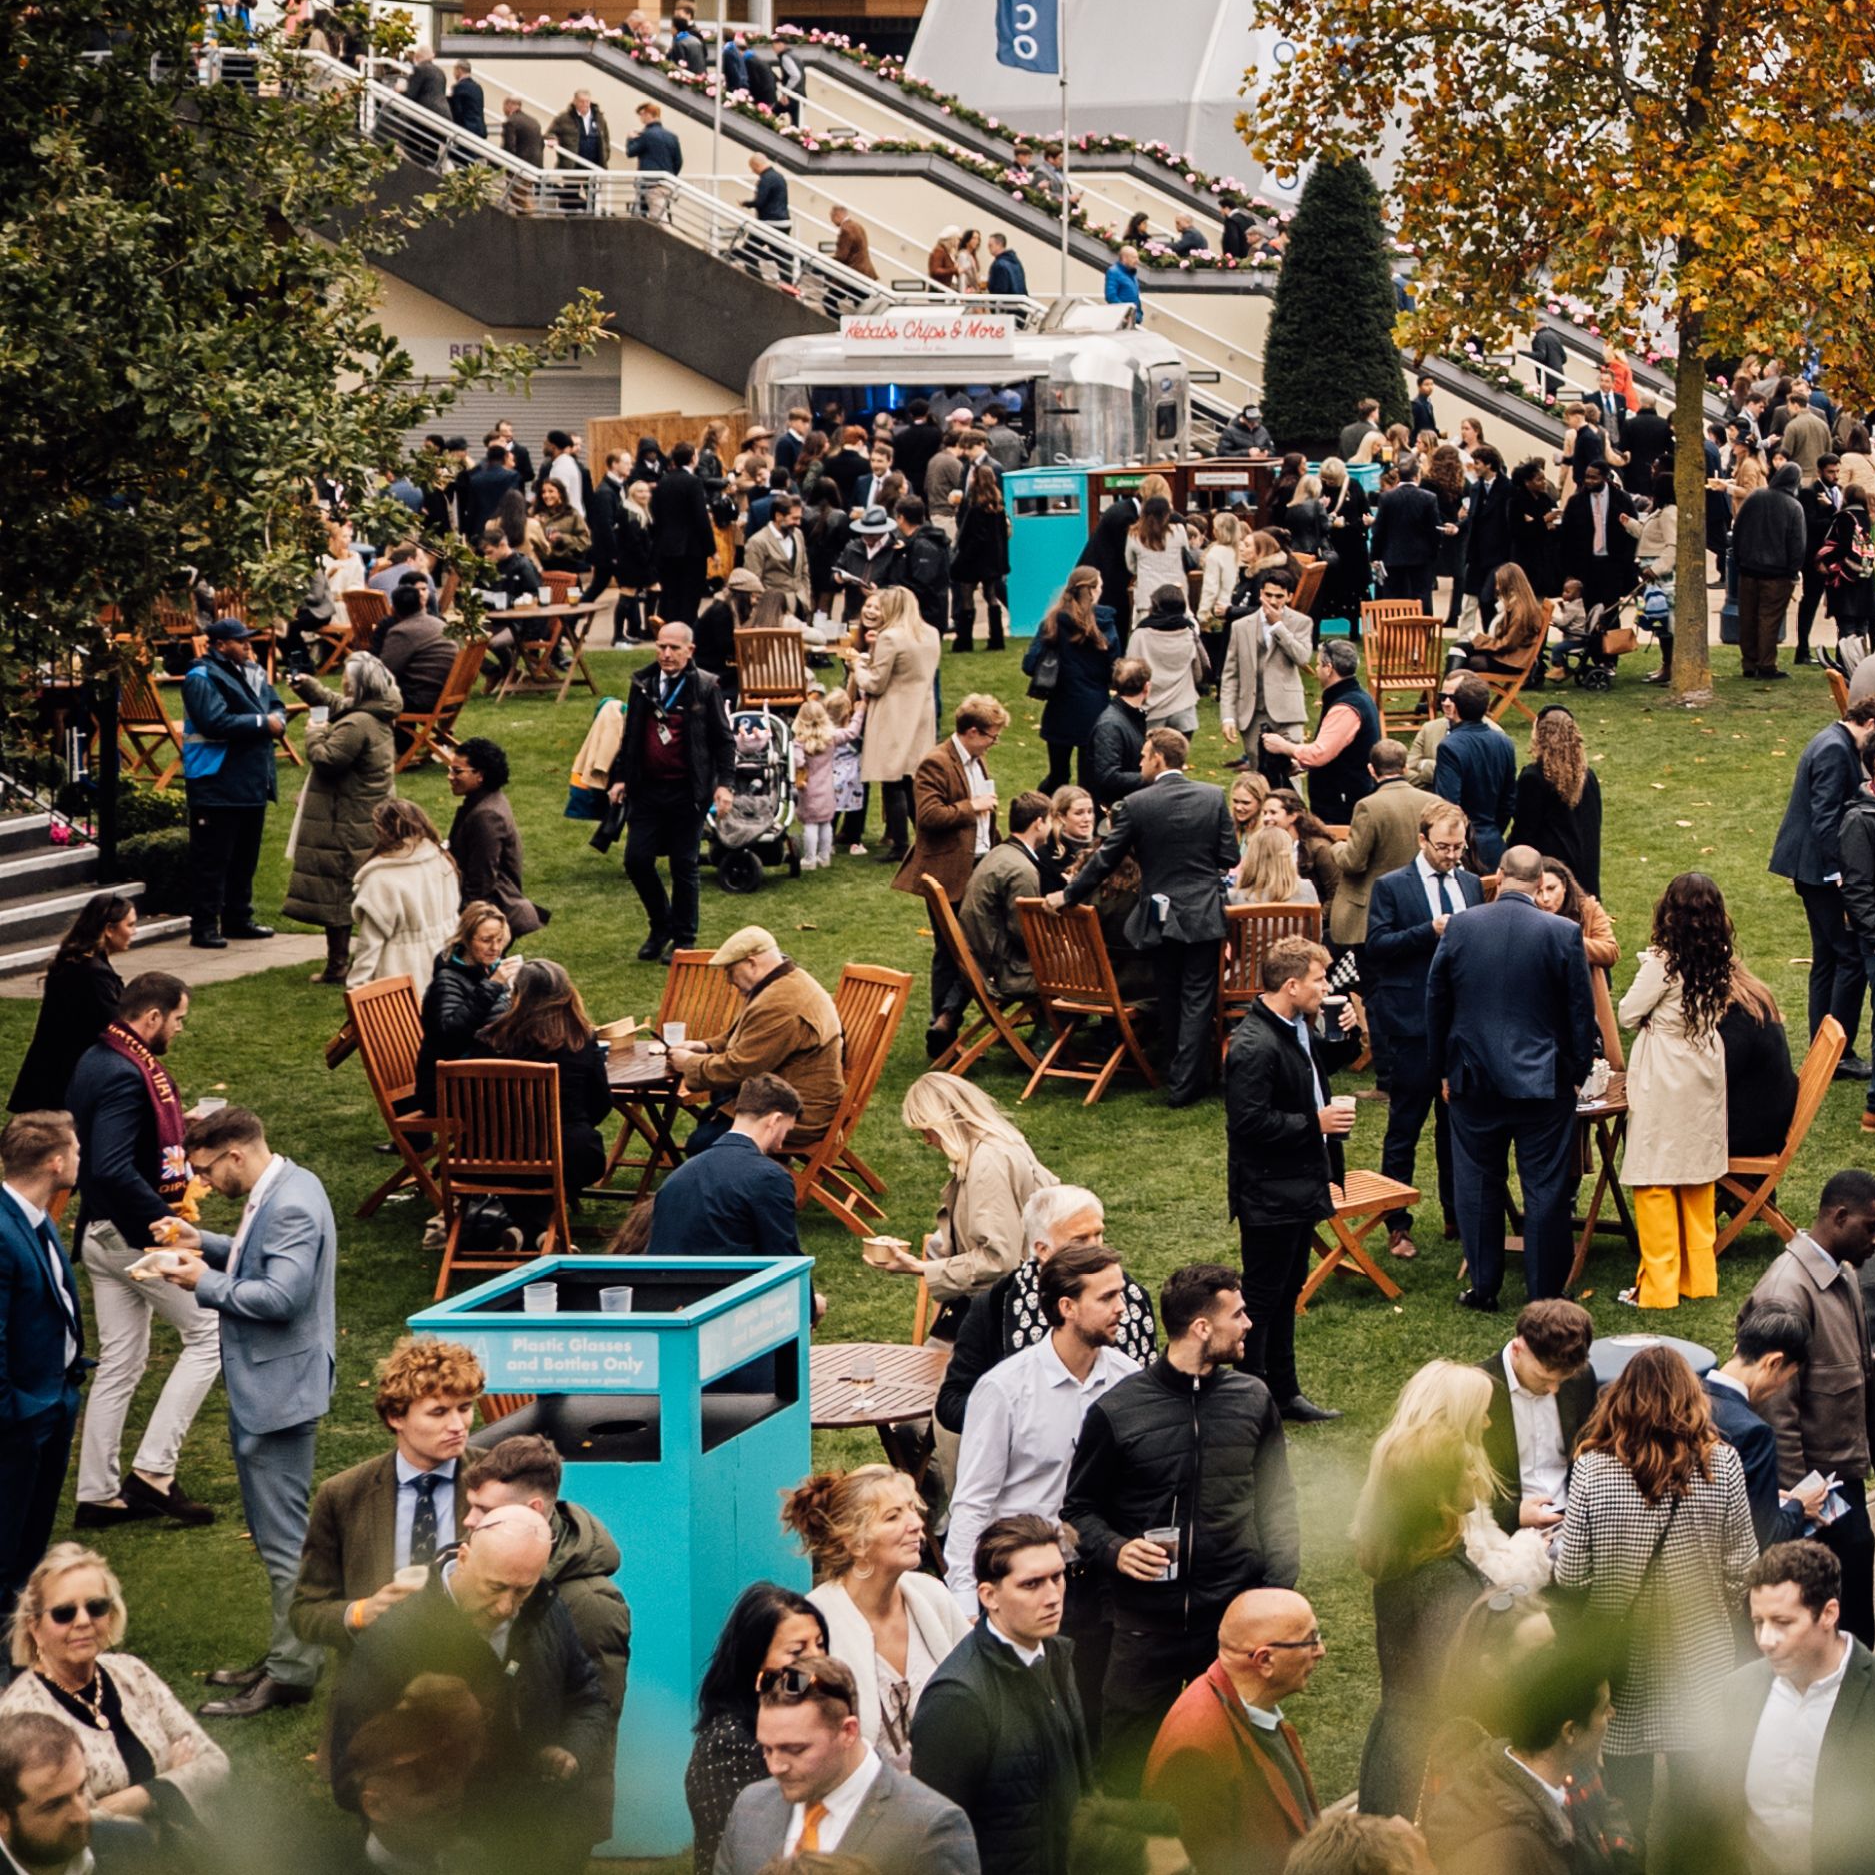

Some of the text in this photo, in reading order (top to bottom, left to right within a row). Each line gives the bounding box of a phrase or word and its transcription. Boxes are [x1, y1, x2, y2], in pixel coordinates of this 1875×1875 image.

[845, 318, 1005, 343] Kebabs Chips & More
[512, 1337, 632, 1353] Plastic Glasses
[506, 1356, 644, 1375] and Bottles Only
